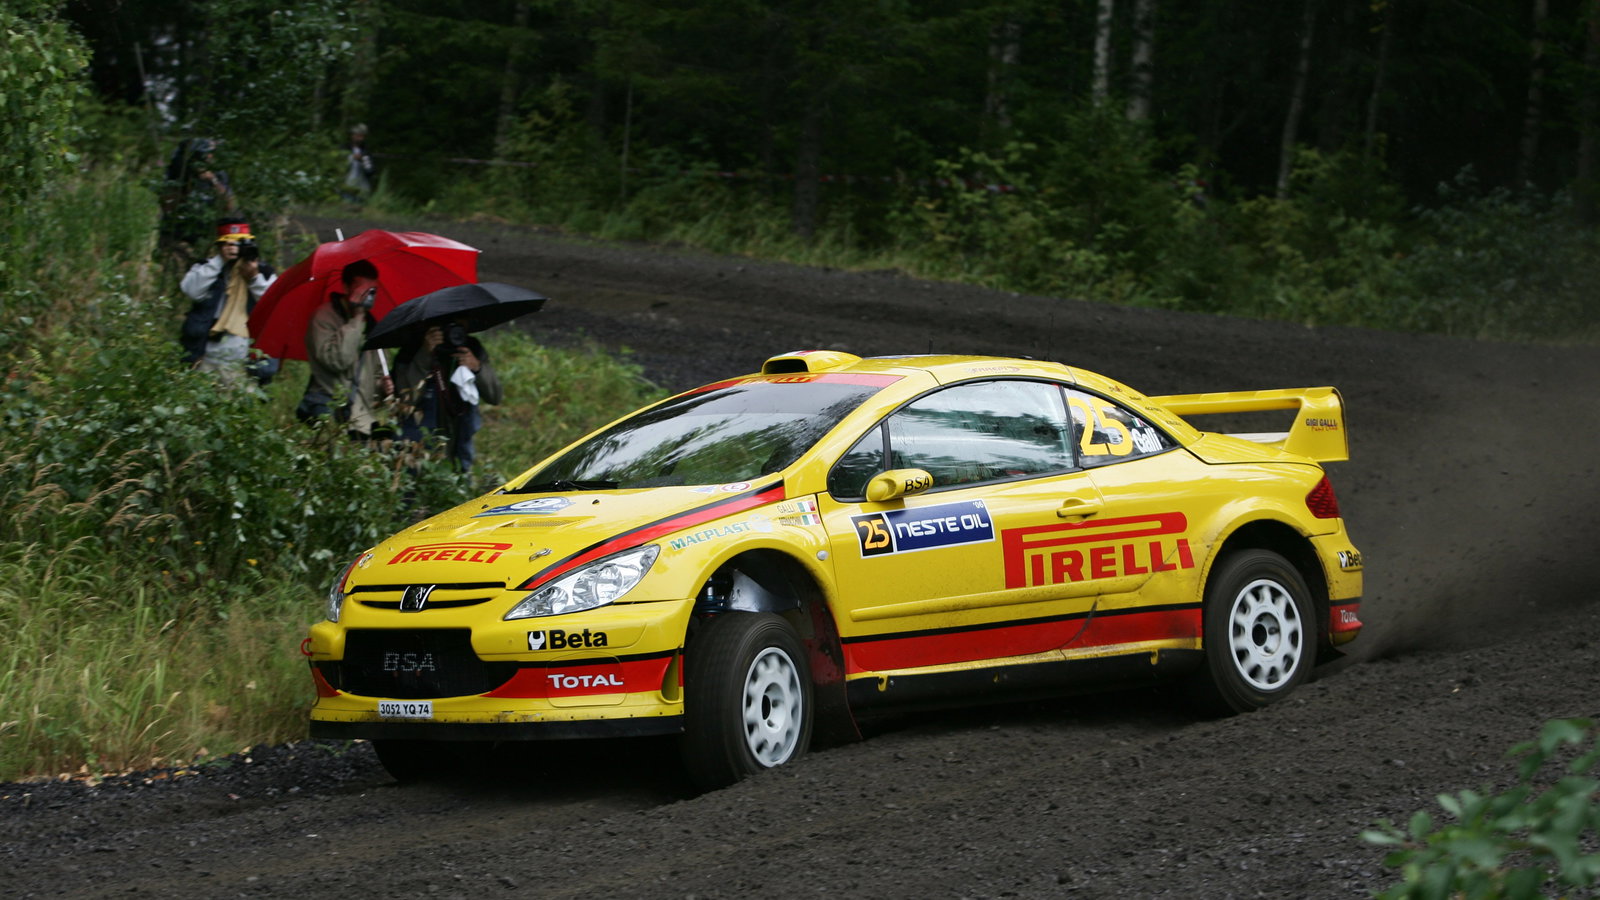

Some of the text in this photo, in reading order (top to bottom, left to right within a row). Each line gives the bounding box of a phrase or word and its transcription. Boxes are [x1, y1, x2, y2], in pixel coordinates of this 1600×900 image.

[1066, 396, 1133, 456] 25
[1131, 427, 1164, 453] Galli
[904, 475, 931, 493] BSA
[670, 521, 750, 550] MACPLAST
[857, 518, 890, 550] 25
[895, 513, 990, 539] NESTE OIL
[386, 541, 514, 566] PIRELLI
[1001, 511, 1195, 589] PIRELLI
[1340, 609, 1359, 624] TOTA
[549, 628, 609, 650] Beta
[384, 653, 437, 672] BSA
[547, 673, 625, 689] TOTAL
[380, 703, 430, 716] 3052 YQ 74
